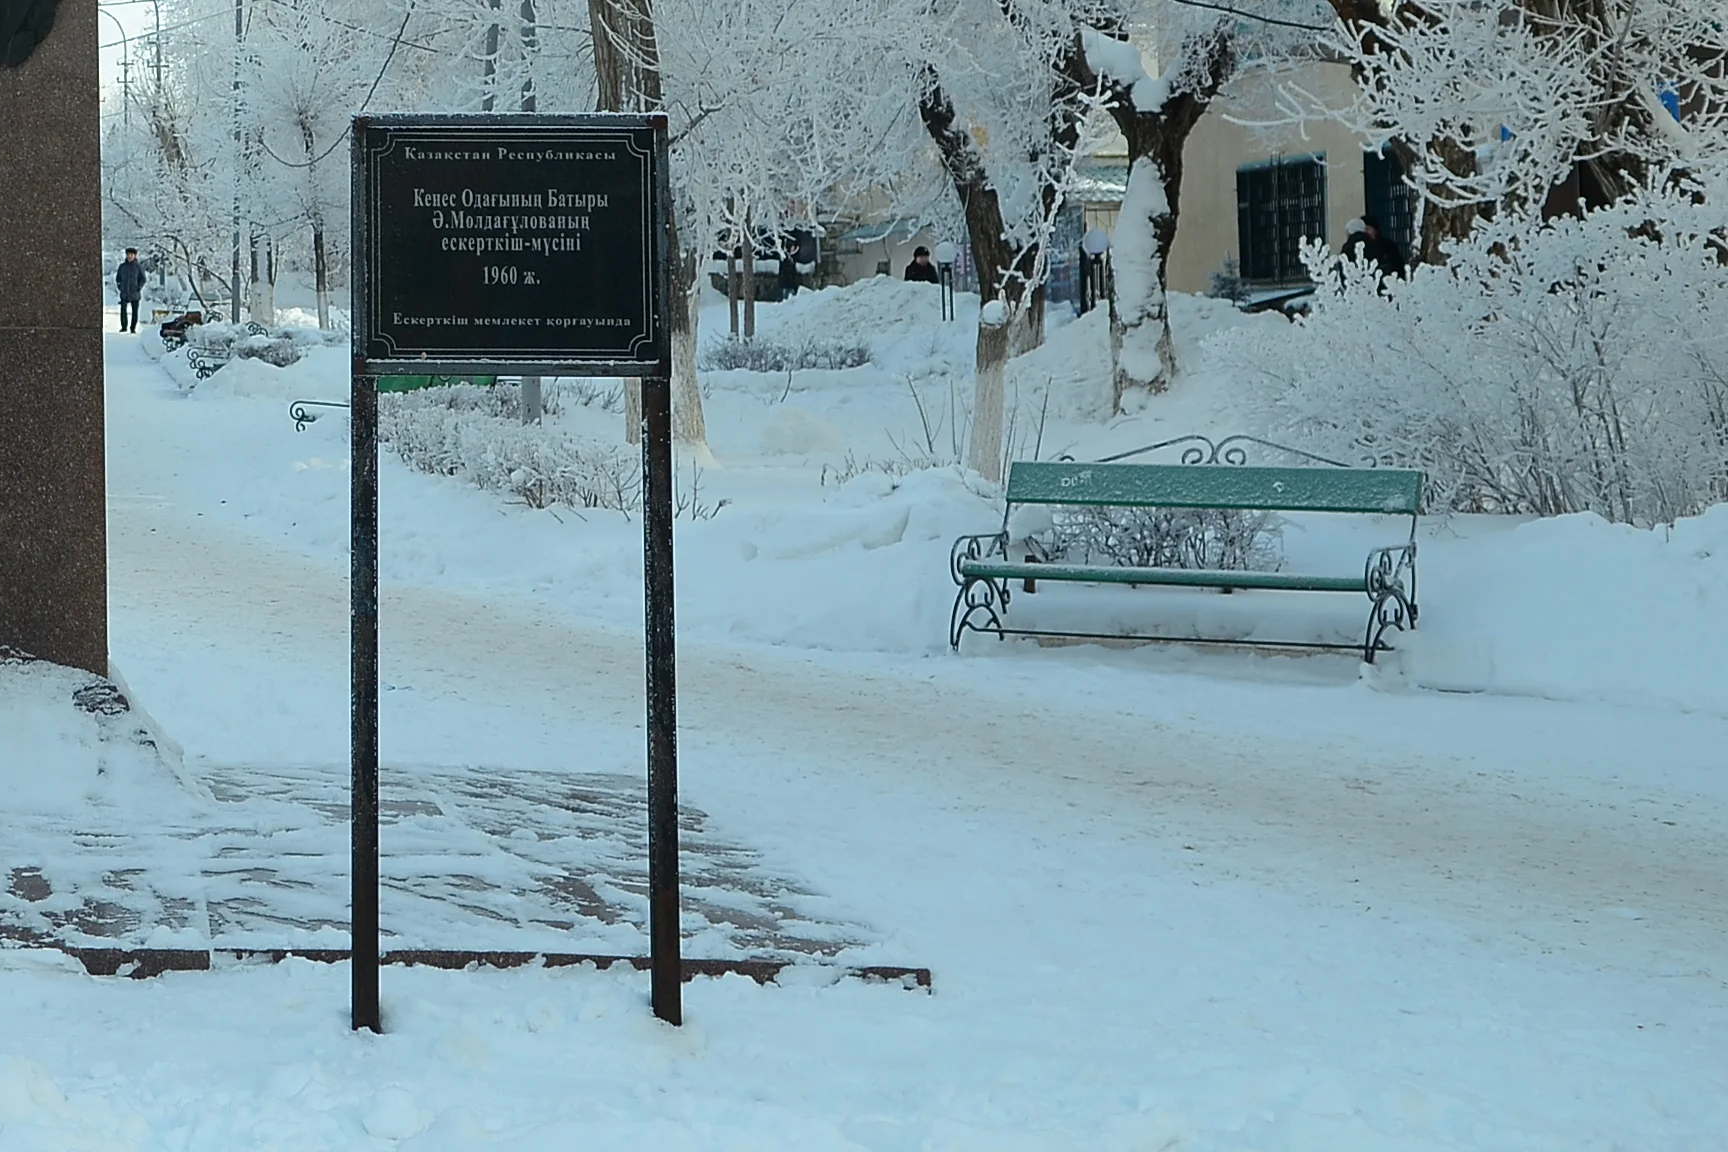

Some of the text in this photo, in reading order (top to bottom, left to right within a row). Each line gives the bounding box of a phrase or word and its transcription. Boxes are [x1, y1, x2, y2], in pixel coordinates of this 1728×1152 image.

[497, 147, 616, 163] Республикасы
[461, 188, 542, 209] Одағының
[547, 188, 609, 212] Батыры
[441, 232, 581, 256] ескерткіш-мүсіні
[483, 265, 541, 285] 1960 ж.
[393, 312, 468, 328] Ескерткіш
[474, 318, 541, 327] мемлекет
